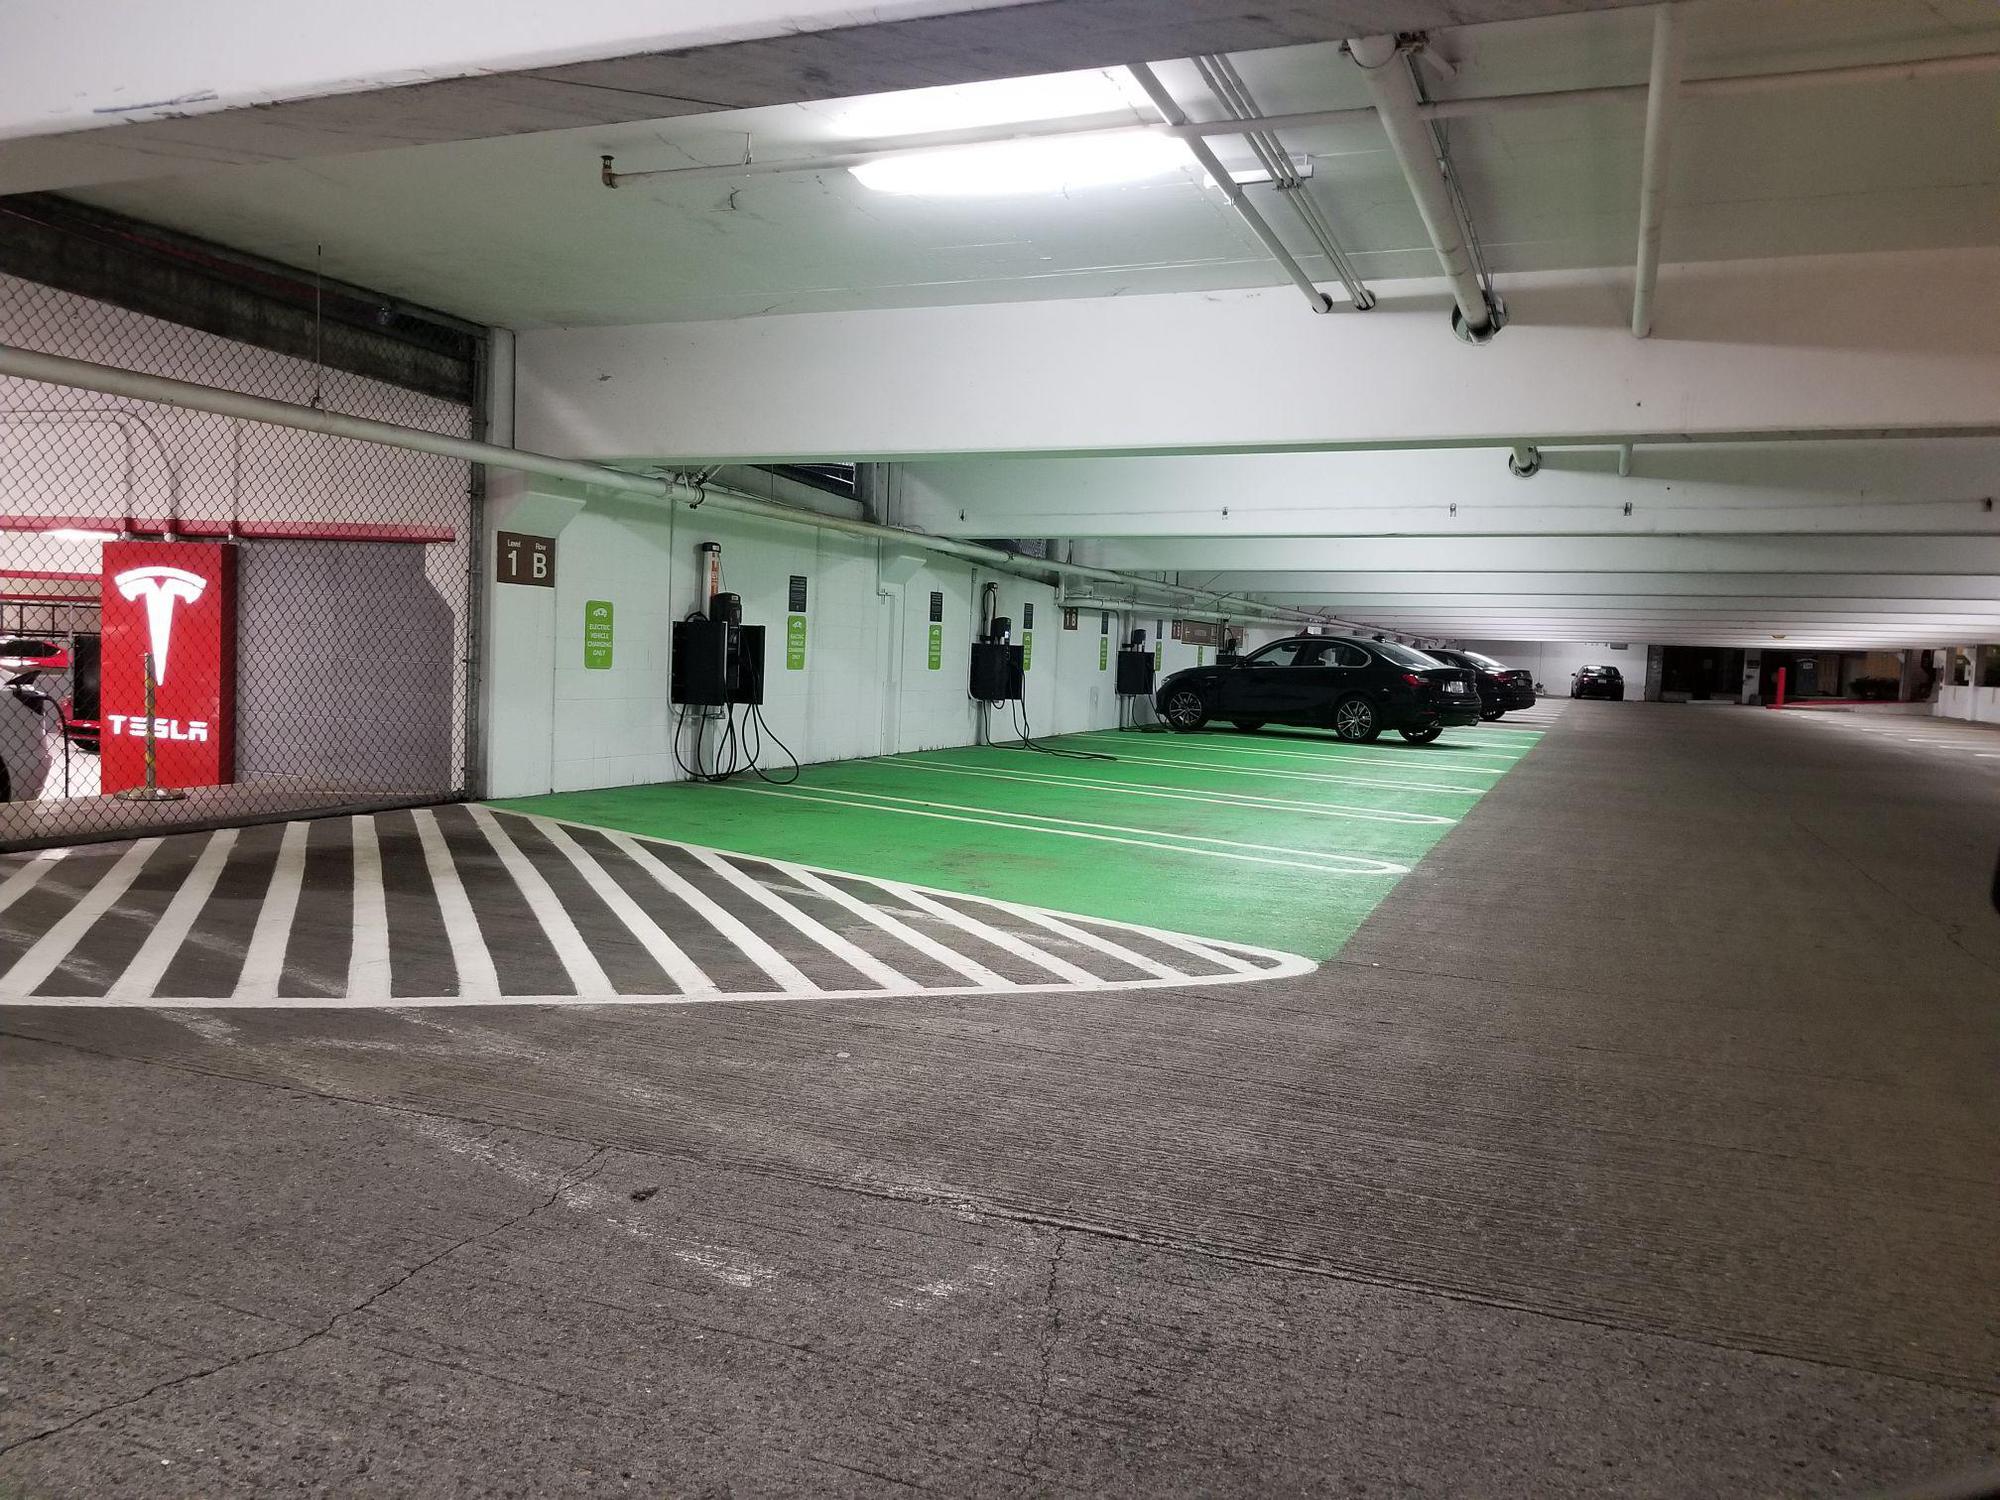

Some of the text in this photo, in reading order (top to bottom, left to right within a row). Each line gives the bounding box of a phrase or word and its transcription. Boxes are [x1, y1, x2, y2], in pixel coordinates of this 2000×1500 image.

[507, 539, 546, 550] Level Row
[507, 550, 547, 578] 1 B
[108, 714, 208, 742] TESLA
